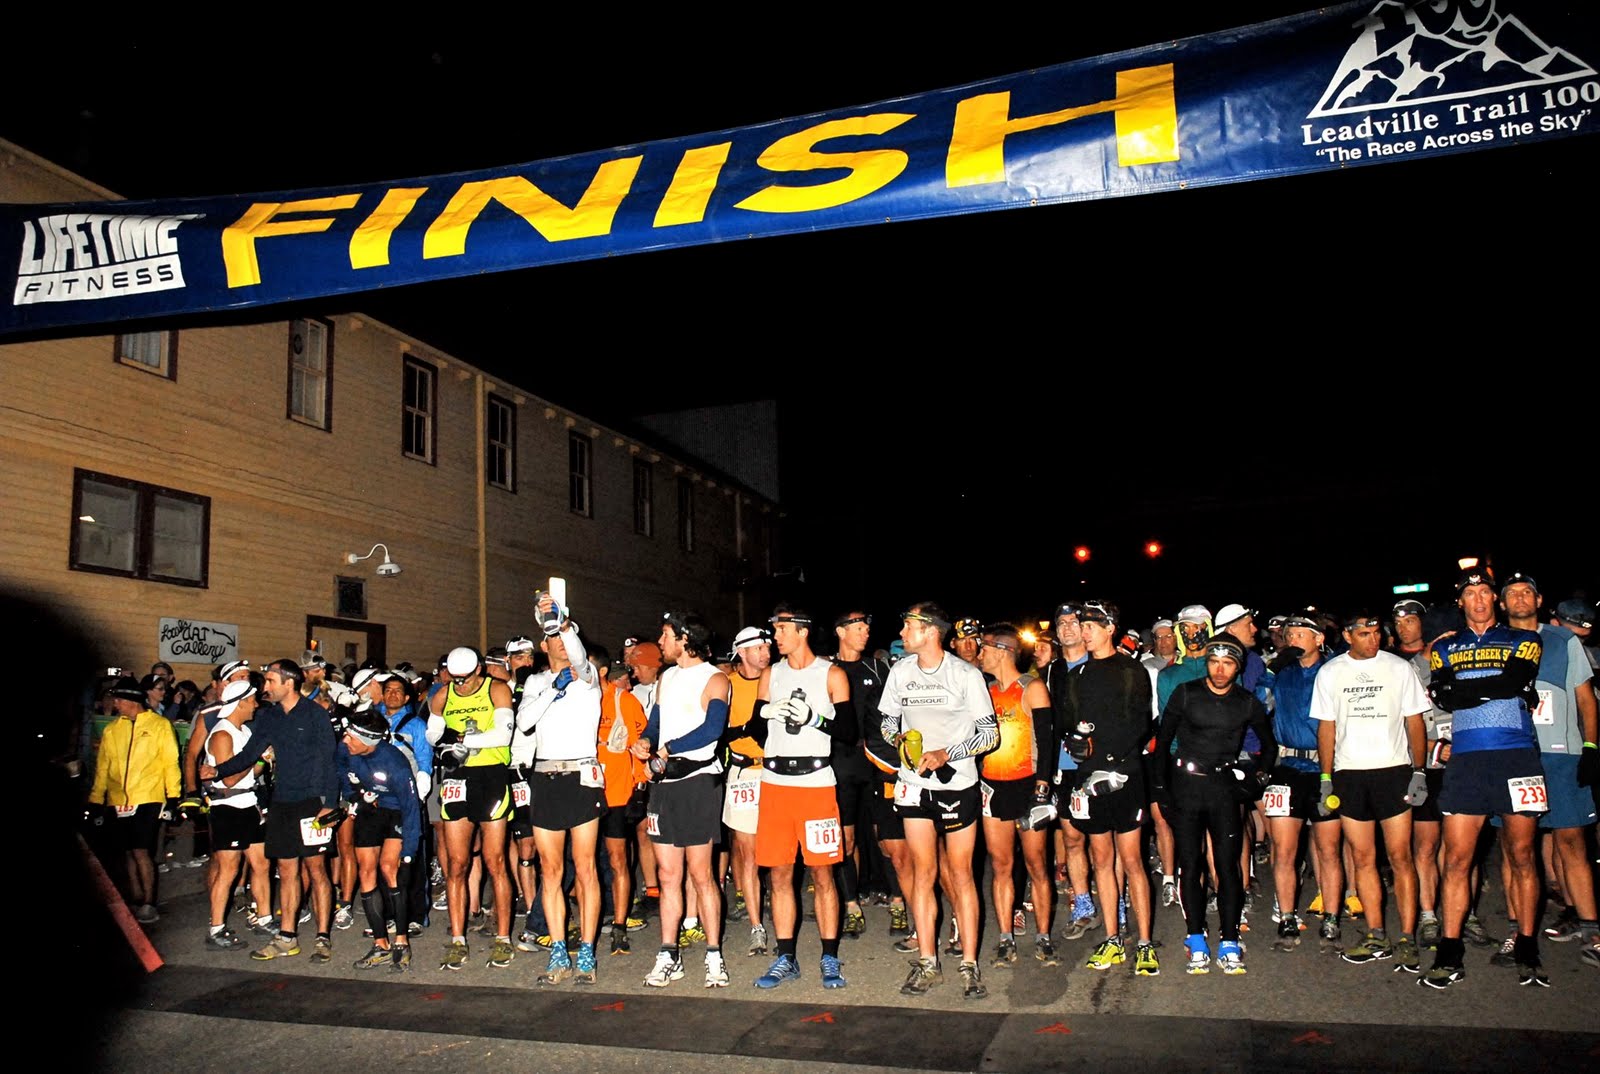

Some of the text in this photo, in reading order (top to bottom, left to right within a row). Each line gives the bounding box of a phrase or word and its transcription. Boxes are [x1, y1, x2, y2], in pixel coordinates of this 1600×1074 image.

[1301, 81, 1600, 146] Leadville Trail 100
[1315, 109, 1592, 163] “The Race Across the Sky”
[221, 63, 1180, 288] FINISH
[18, 213, 206, 275] LIFETIME
[24, 263, 175, 298] FITNESS
[171, 640, 226, 663] Gallery
[1475, 649, 1501, 660] CREEK
[446, 706, 489, 716] BROOKS
[592, 766, 598, 781] 8
[443, 786, 461, 799] 456
[733, 788, 756, 804] 793
[1518, 785, 1546, 805] 233
[814, 828, 837, 845] 161
